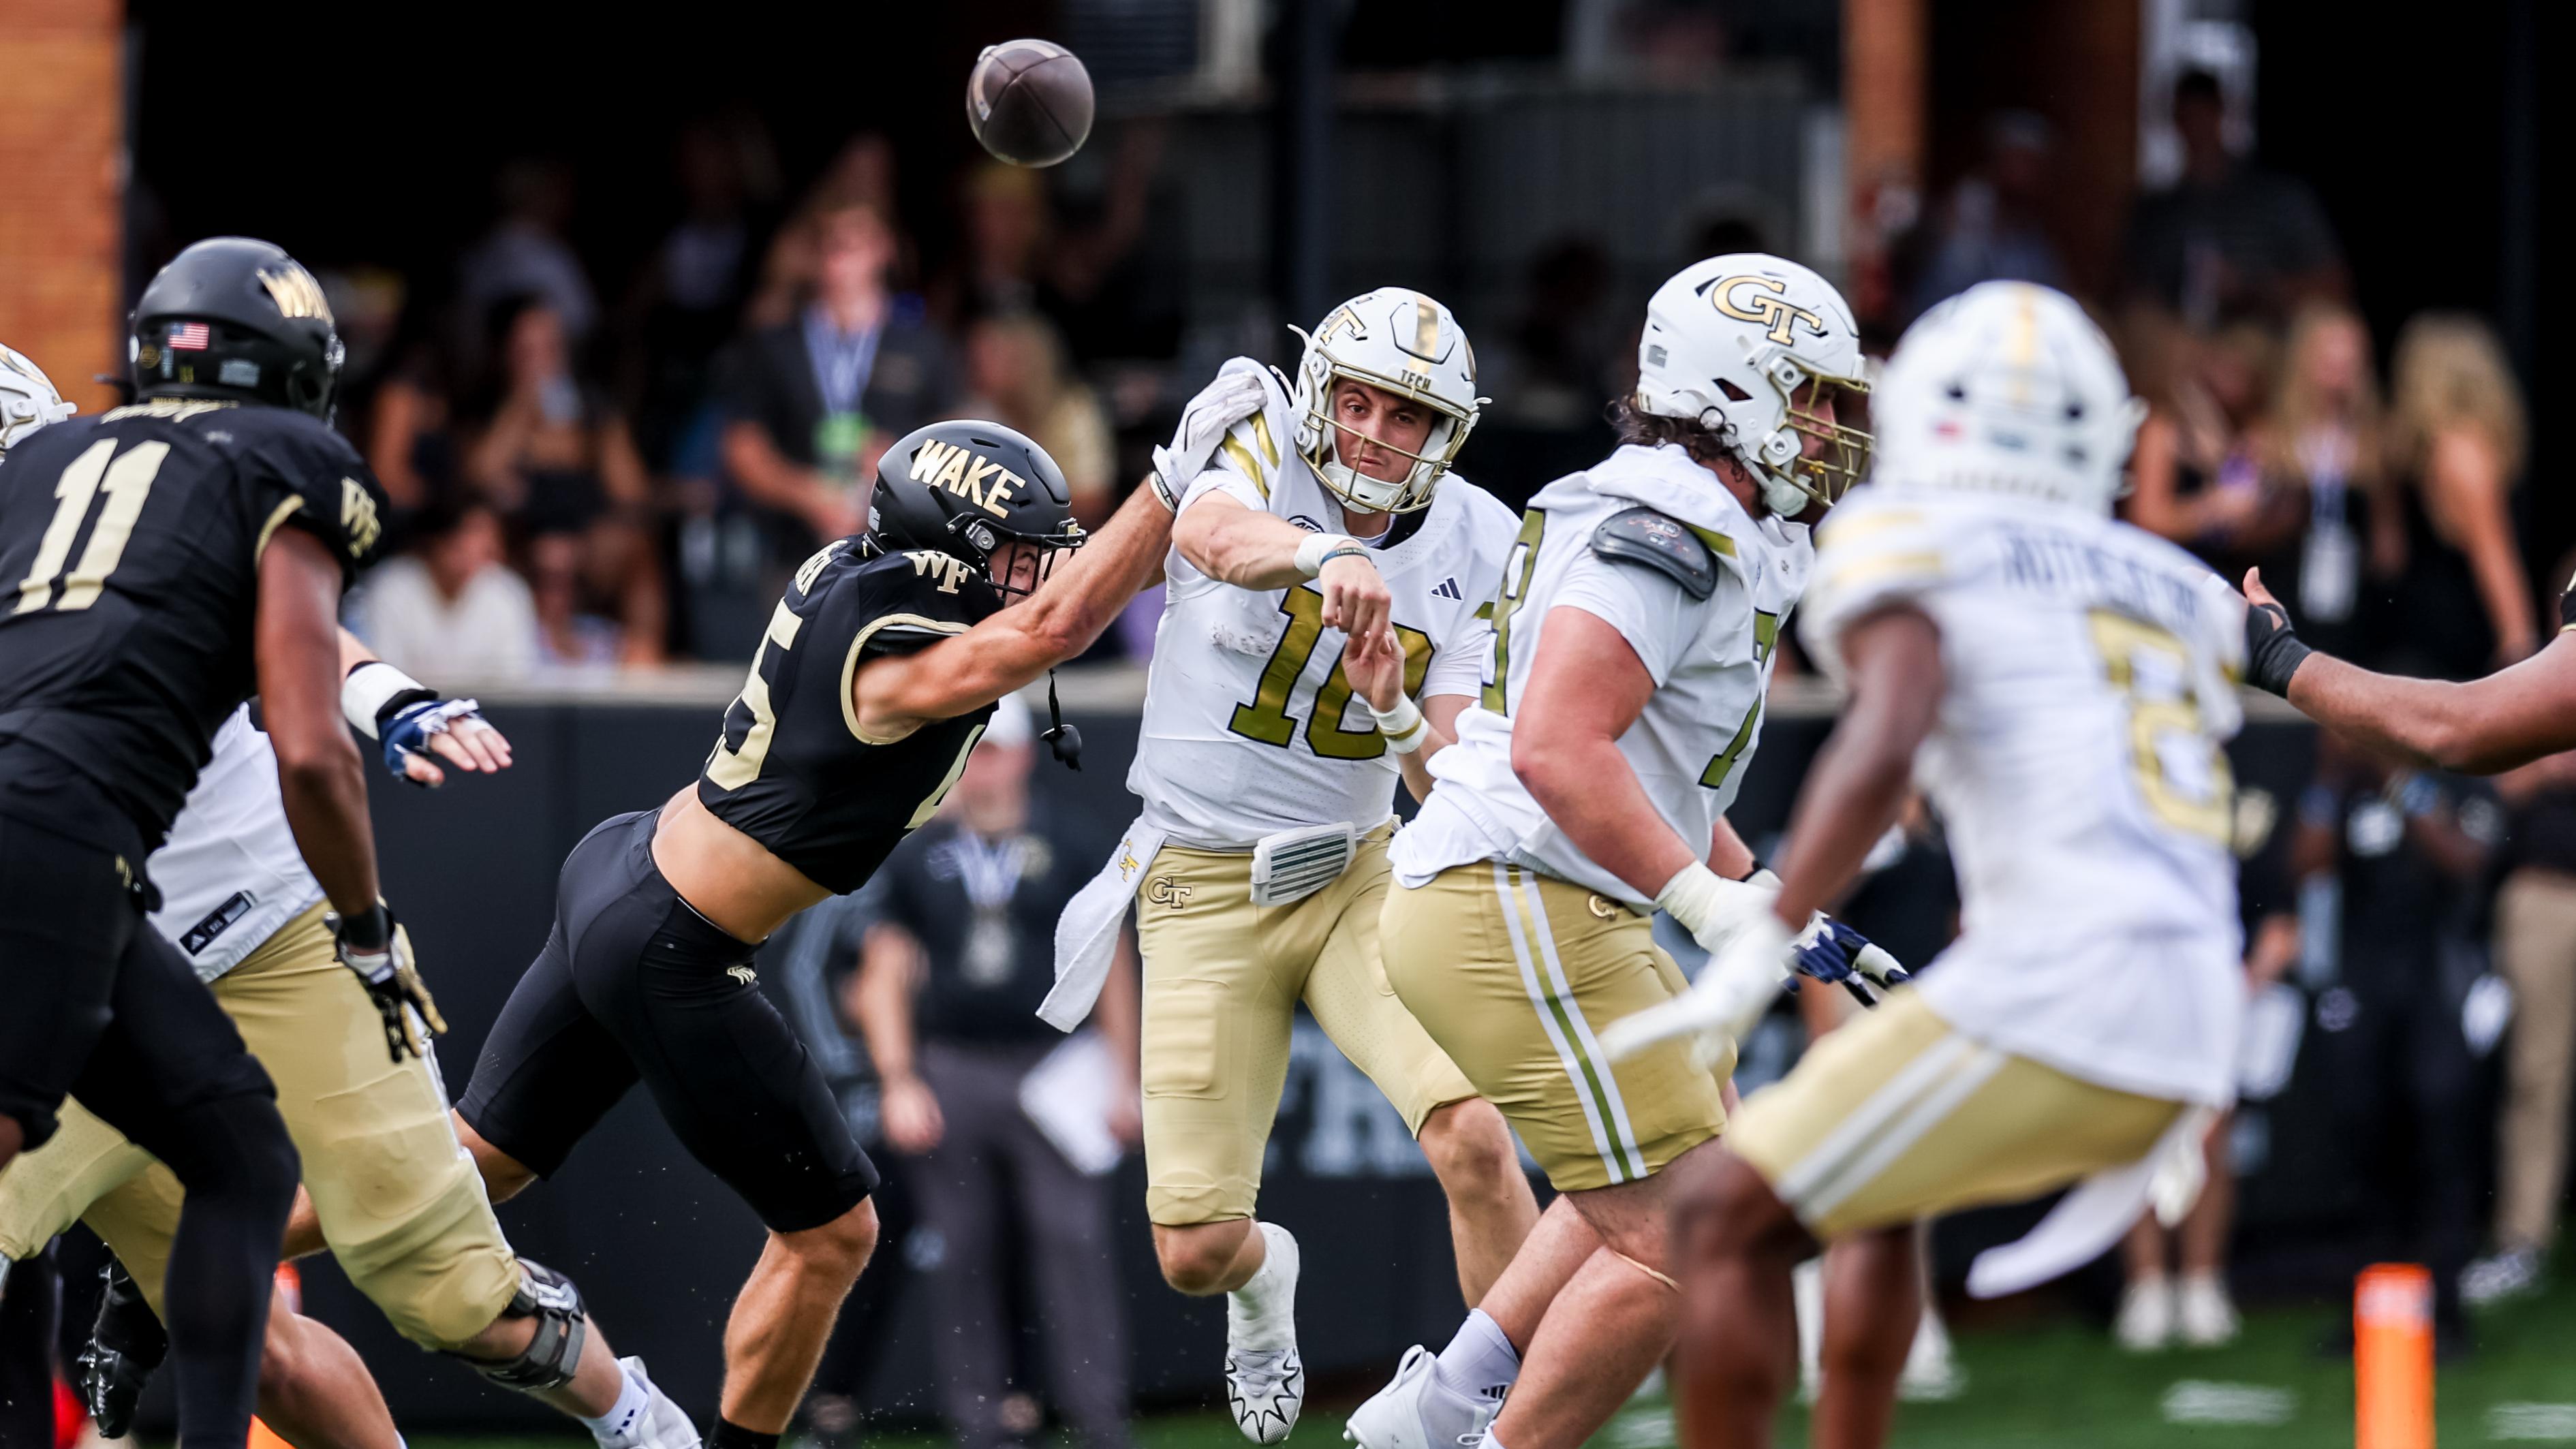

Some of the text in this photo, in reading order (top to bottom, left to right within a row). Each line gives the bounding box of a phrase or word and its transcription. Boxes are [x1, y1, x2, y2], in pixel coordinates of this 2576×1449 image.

[1711, 275, 1825, 346] GT
[1402, 369, 1431, 390] TECH
[909, 438, 1026, 519] WAKE
[10, 437, 171, 614] 11
[902, 548, 977, 595] WF
[1227, 585, 1436, 762] 10
[1118, 837, 1140, 883] GT
[1147, 876, 1193, 909] GT
